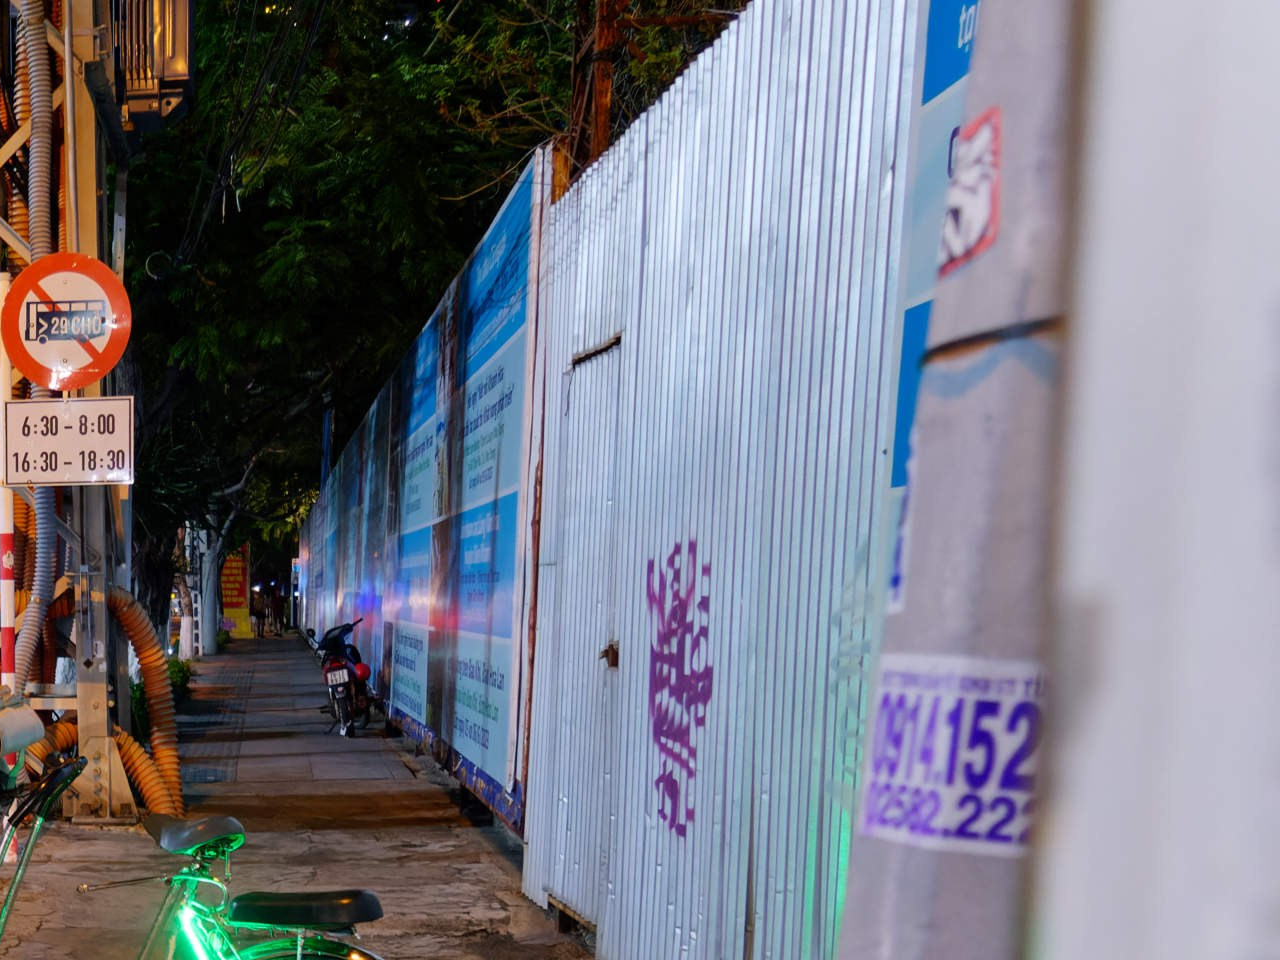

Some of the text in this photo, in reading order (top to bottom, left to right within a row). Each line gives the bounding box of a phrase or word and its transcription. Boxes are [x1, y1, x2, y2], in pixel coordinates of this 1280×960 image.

[51, 316, 68, 335] 29
[21, 415, 59, 437] 6:30
[78, 413, 116, 436] 8:00
[12, 450, 58, 473] 16:30
[78, 449, 126, 472] 18:30
